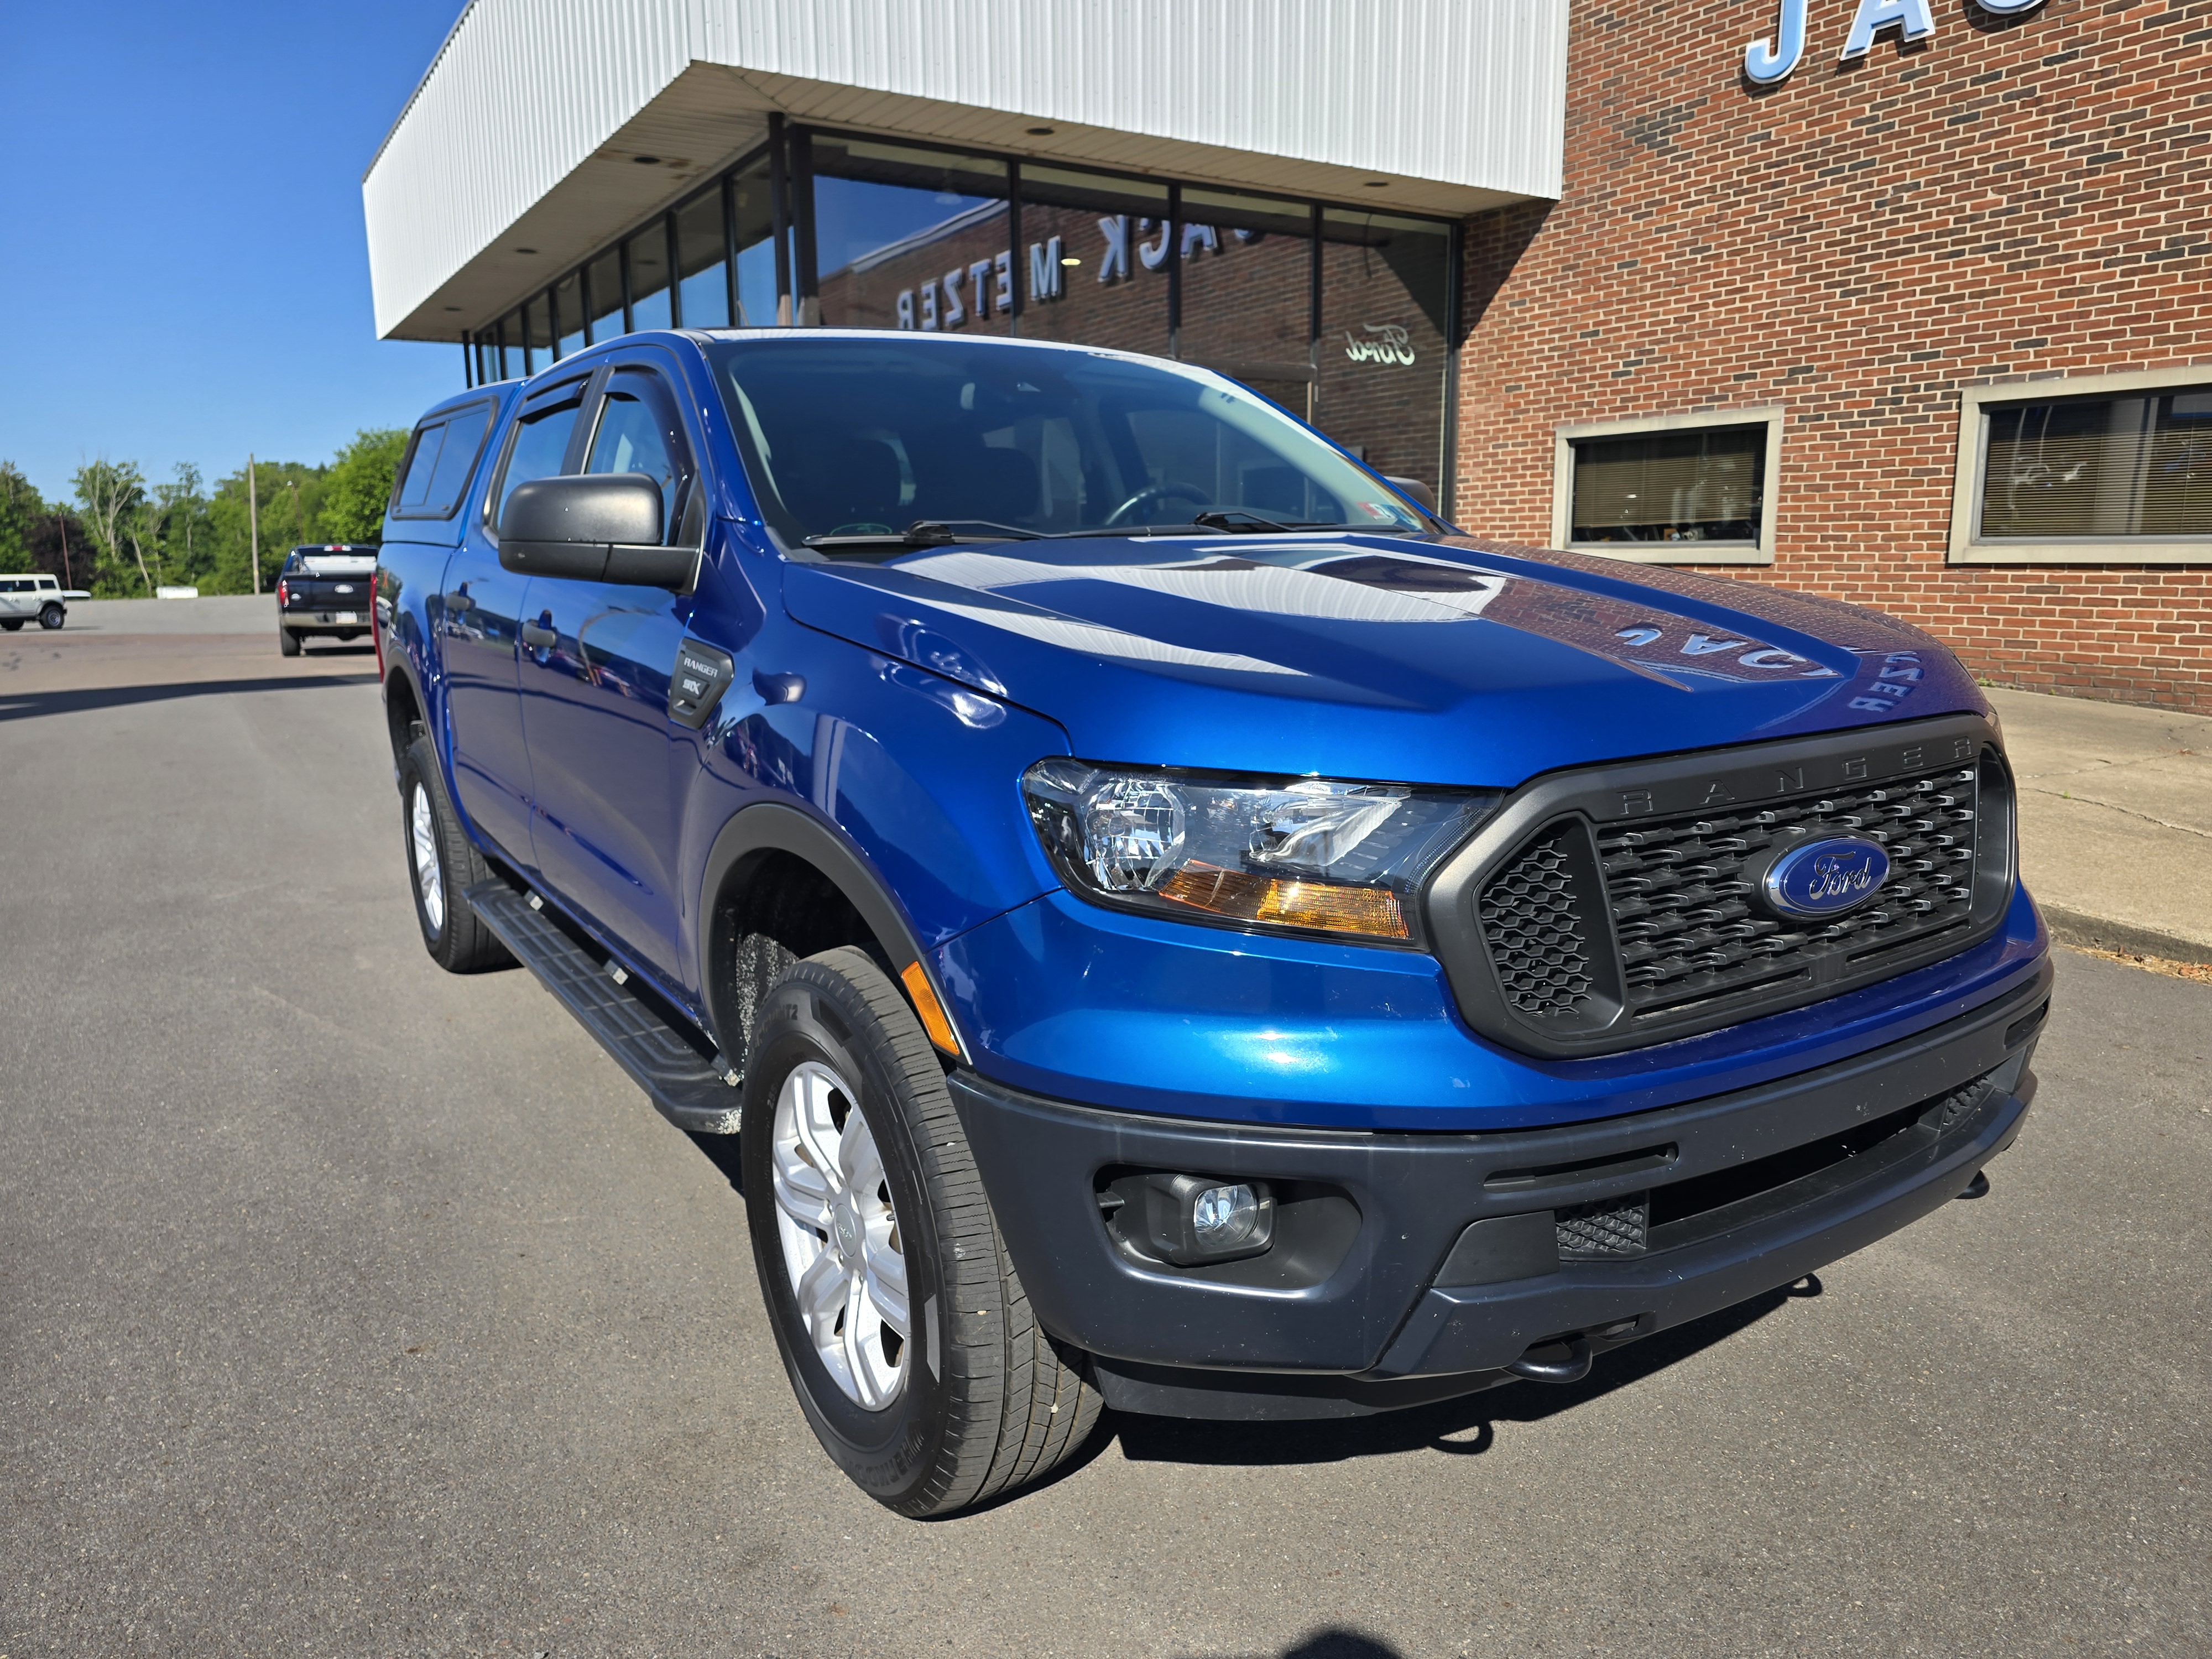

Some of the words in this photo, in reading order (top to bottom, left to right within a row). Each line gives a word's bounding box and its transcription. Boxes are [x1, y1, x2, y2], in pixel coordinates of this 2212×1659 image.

[1745, 0, 2046, 84] JA
[684, 657, 718, 678] RANGER
[1619, 736, 1971, 815] RANGER
[1809, 851, 1872, 900] Ford
